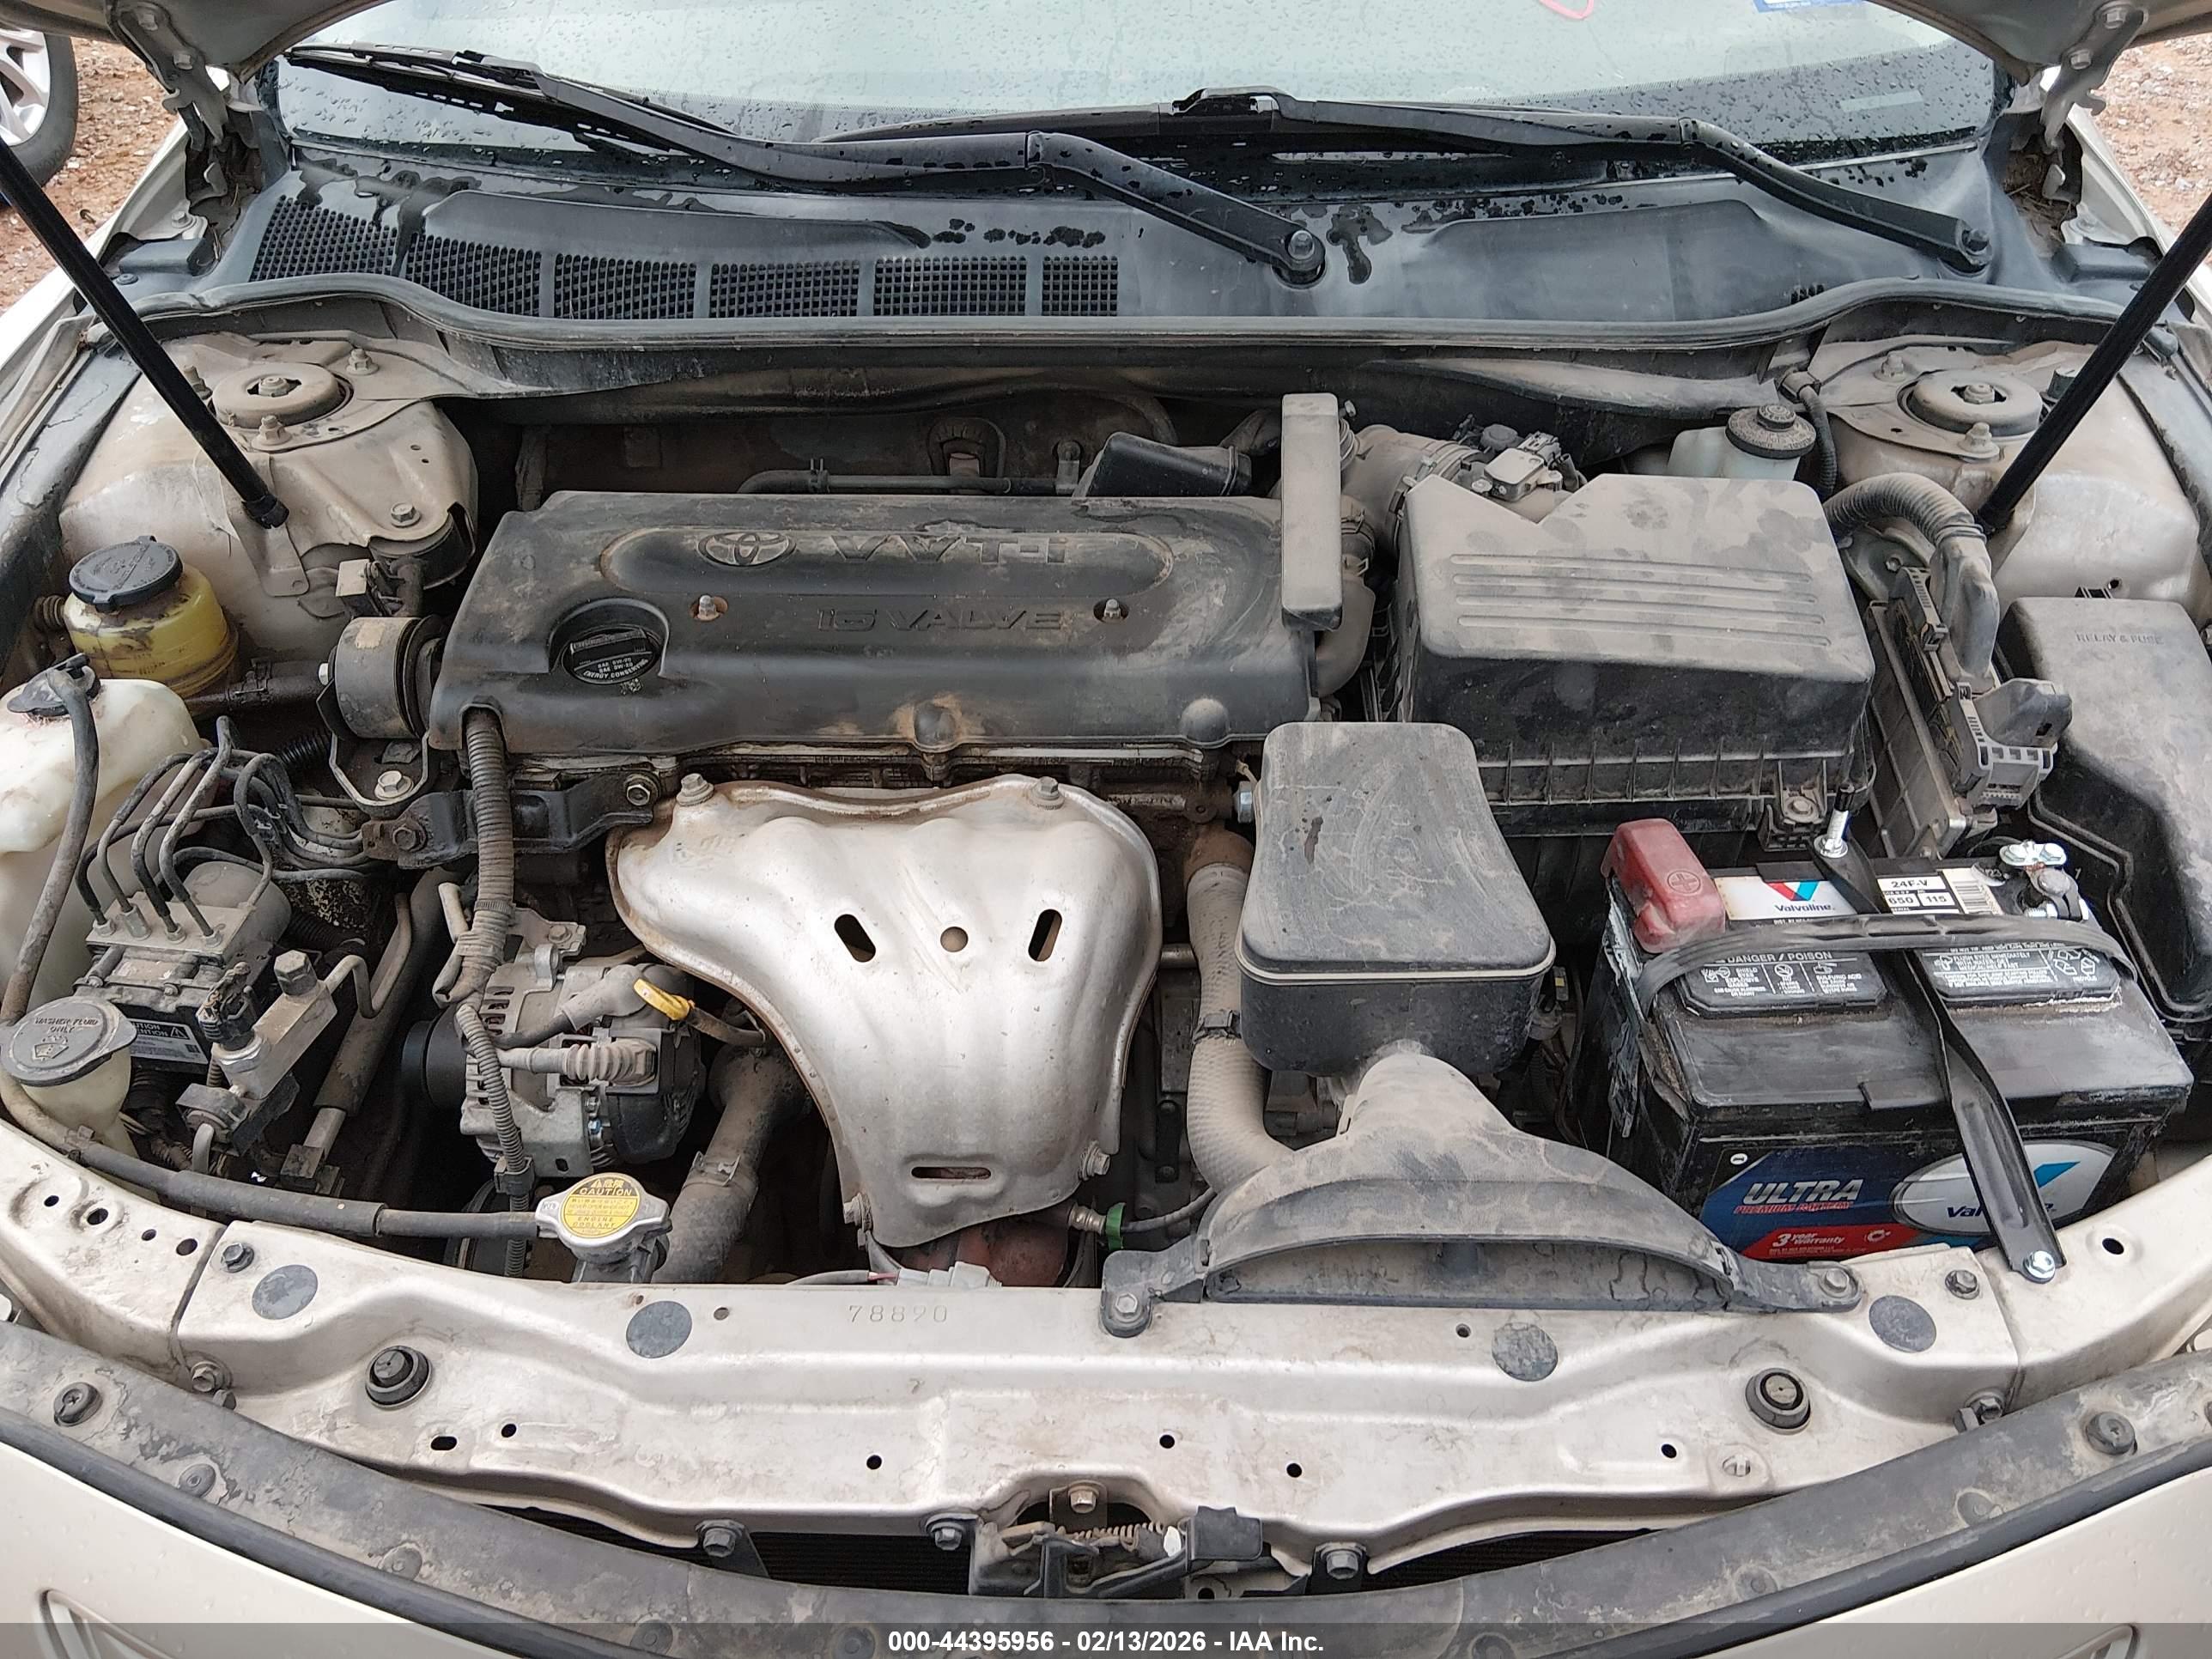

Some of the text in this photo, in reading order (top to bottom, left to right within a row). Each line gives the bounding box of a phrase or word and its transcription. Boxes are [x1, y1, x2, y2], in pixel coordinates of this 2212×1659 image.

[1926, 895, 1947, 903] 115
[1774, 904, 1832, 913] Valvoline
[1788, 951, 1832, 961] POISON
[579, 1188, 632, 1196] CAUTION
[1743, 1179, 1863, 1204] ULTRA
[1771, 1233, 1791, 1248] 3
[1794, 1235, 1845, 1245] warranty
